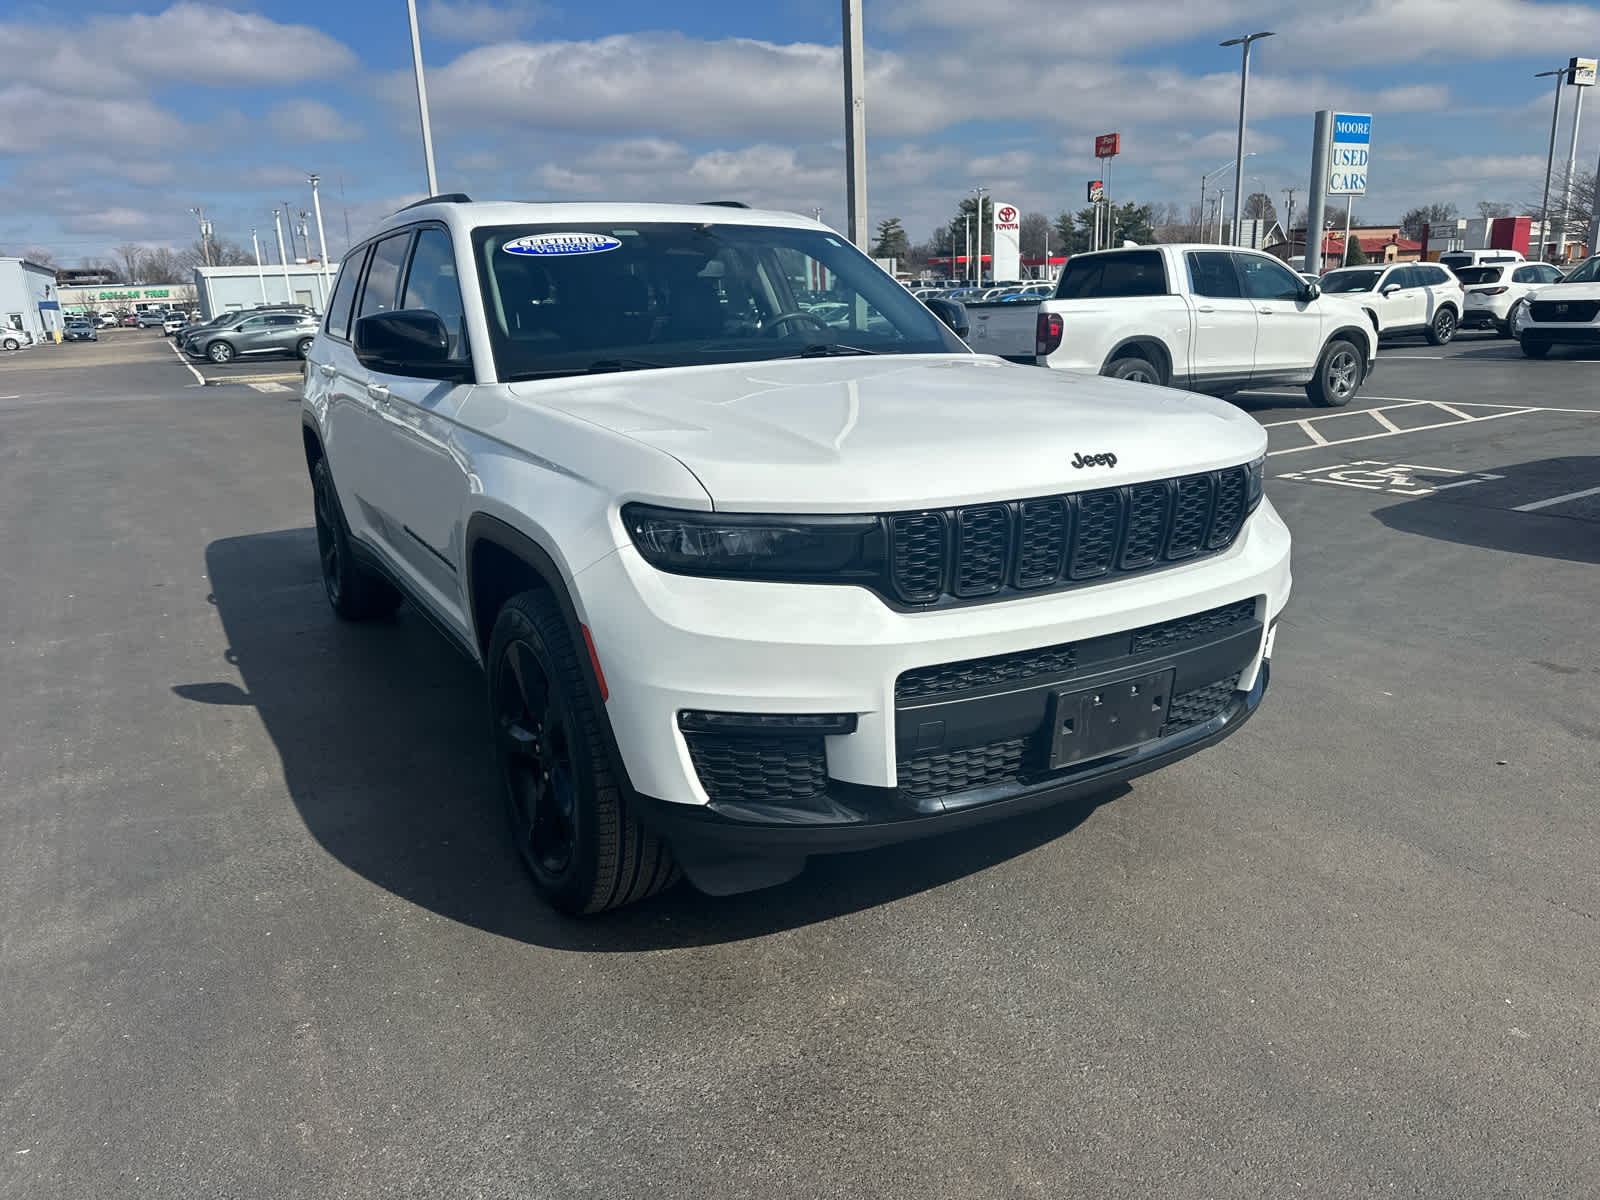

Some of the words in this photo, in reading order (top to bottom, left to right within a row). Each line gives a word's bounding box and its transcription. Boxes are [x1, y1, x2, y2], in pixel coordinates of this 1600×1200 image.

[1336, 121, 1369, 134] MOORE
[1333, 148, 1368, 166] USED
[1330, 173, 1366, 190] CARS
[517, 236, 607, 246] CERTIFIED
[99, 291, 140, 300] DOLLAR
[1071, 452, 1118, 469] Jeep
